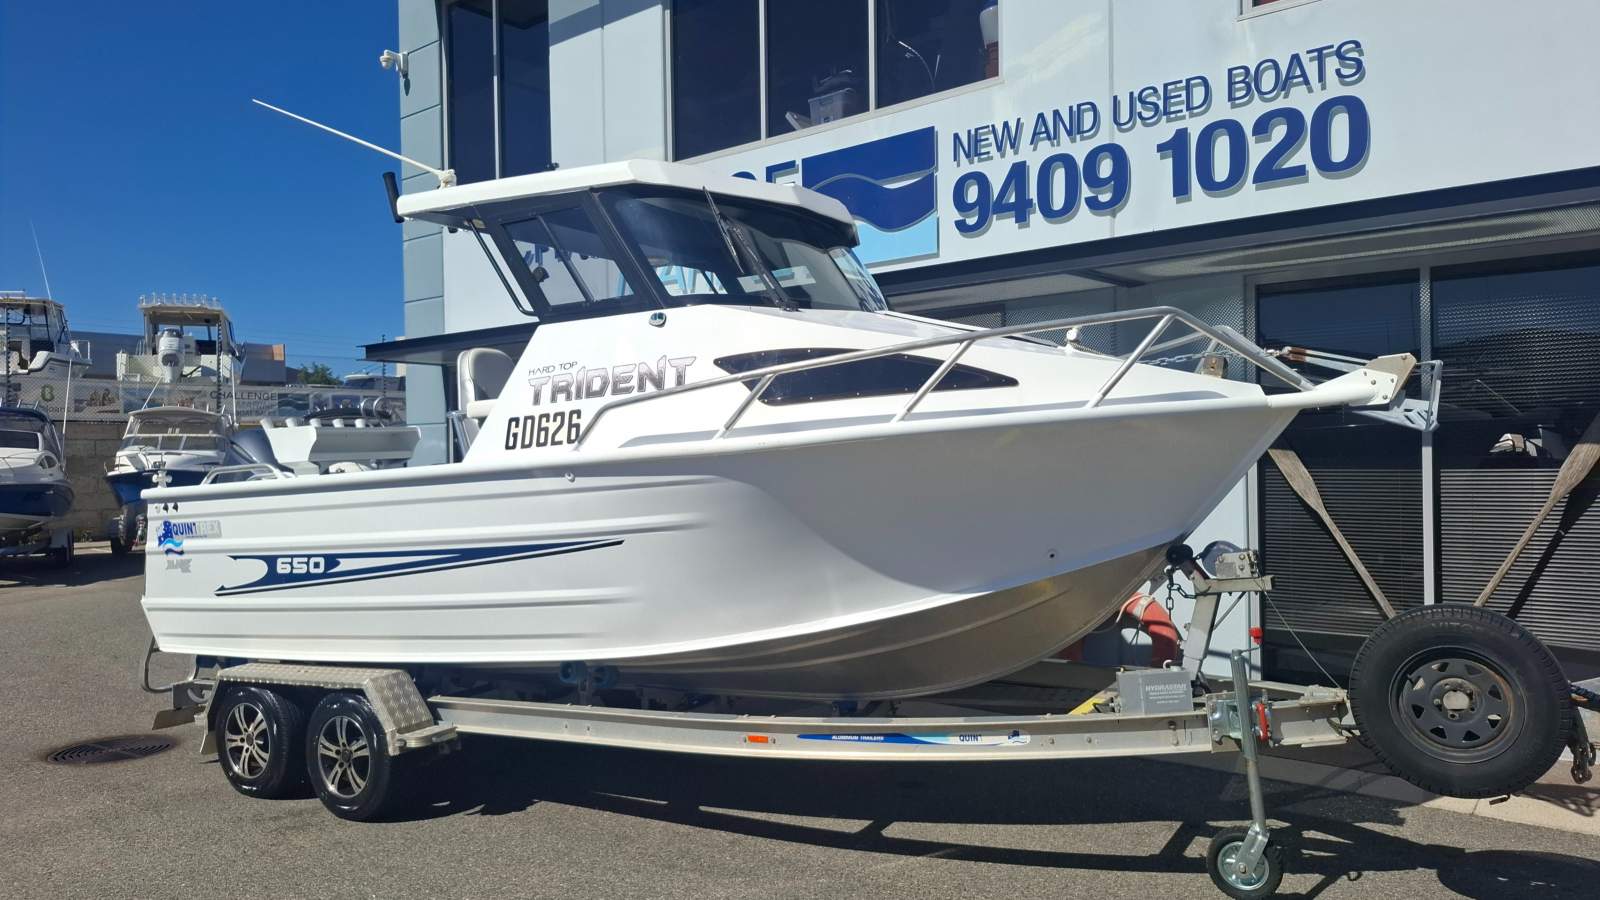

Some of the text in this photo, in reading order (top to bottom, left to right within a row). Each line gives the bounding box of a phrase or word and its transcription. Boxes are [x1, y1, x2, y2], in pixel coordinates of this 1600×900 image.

[953, 39, 1365, 166] NEW AND USED BOATS
[952, 95, 1370, 237] 9409 1020
[528, 361, 578, 376] HARD TOP
[528, 355, 697, 406] TRIDENT
[209, 391, 277, 401] CHALLENGE
[505, 409, 582, 450] GD626
[276, 556, 325, 574] 650
